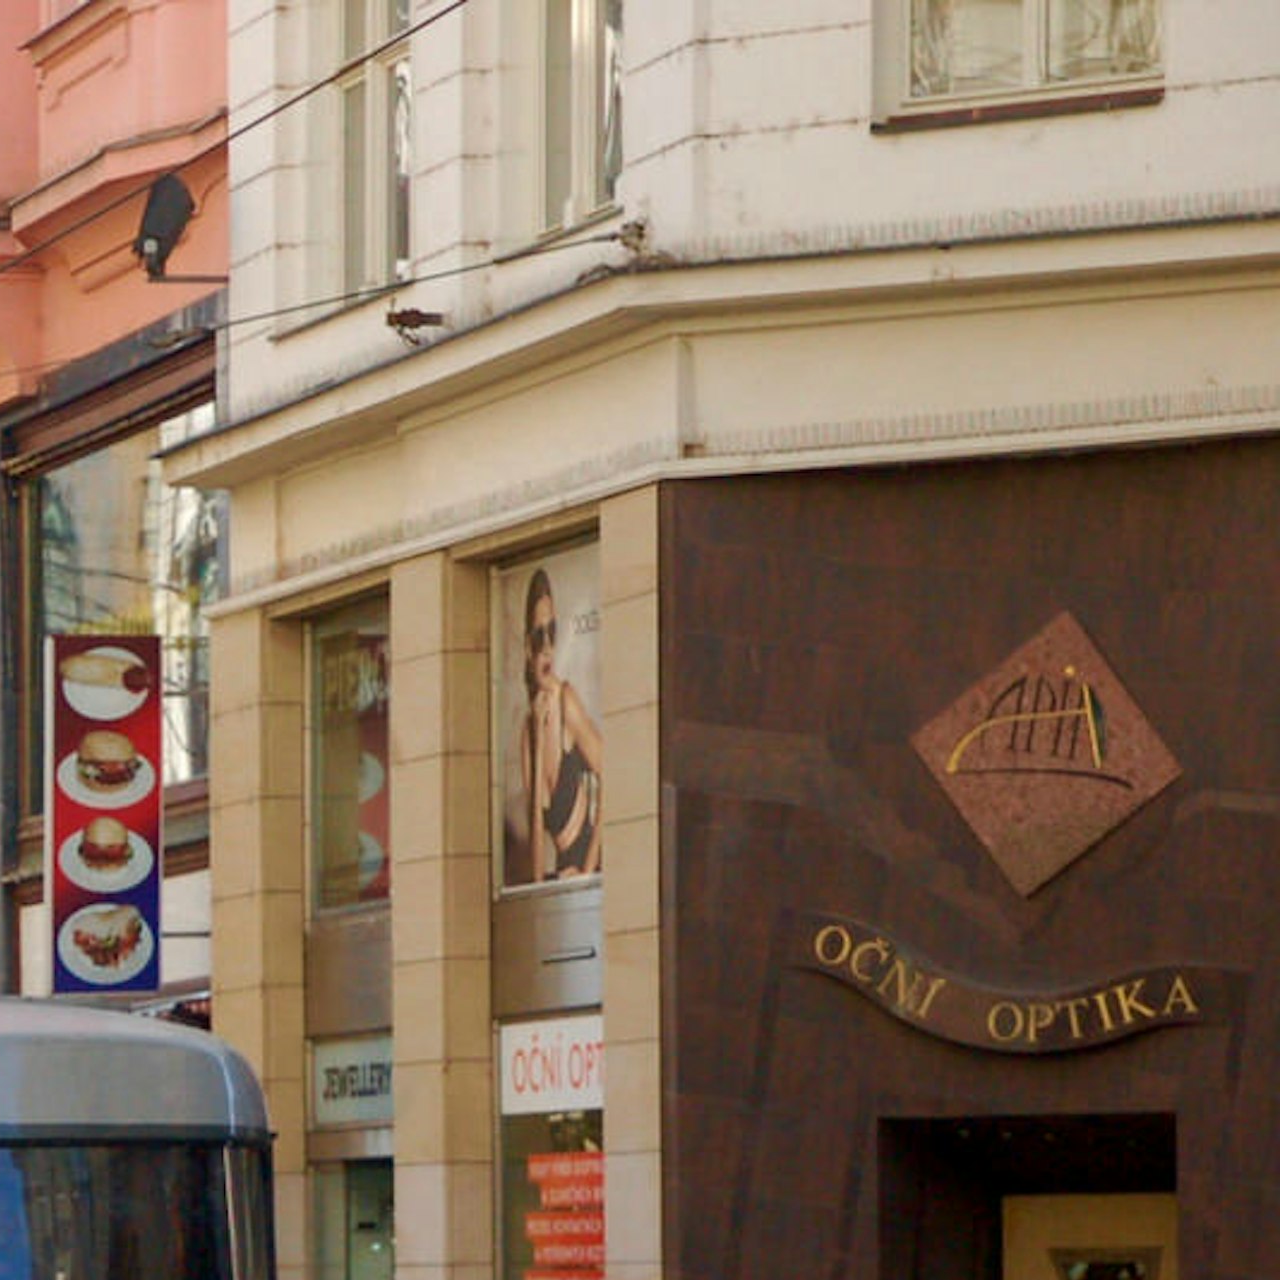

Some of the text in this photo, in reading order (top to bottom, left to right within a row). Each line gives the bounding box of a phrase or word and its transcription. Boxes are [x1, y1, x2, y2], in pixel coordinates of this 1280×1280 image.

[814, 925, 1199, 1043] OČNÍ OPTIKA
[512, 1033, 563, 1095] OČNÍ
